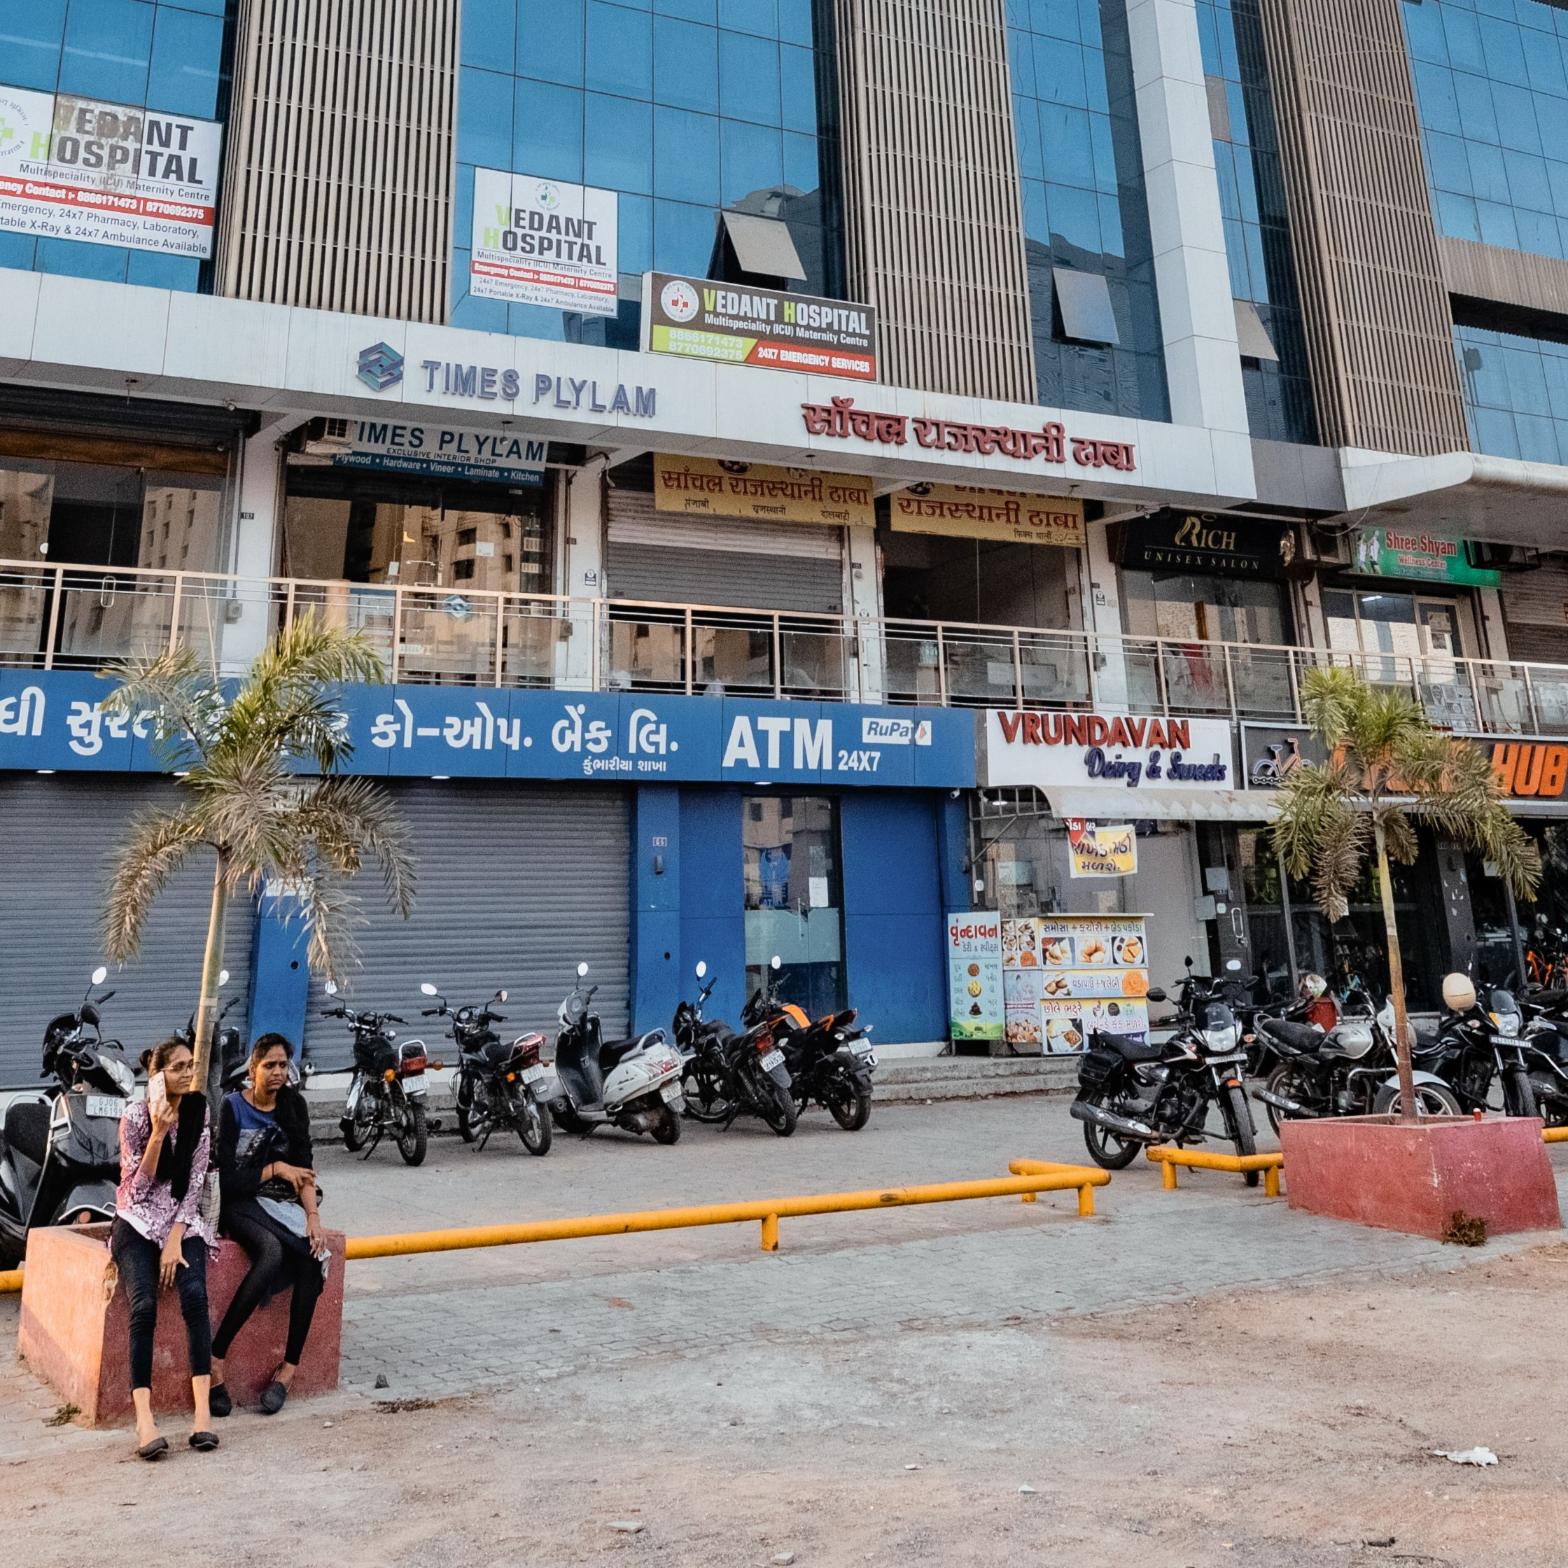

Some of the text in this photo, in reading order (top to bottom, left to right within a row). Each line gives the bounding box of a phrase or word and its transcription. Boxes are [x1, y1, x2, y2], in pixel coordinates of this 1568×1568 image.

[54, 97, 194, 152] VEDANT
[30, 131, 204, 186] HOSPITAL
[19, 163, 211, 202] Multispeciality Maternity Centre
[24, 182, 66, 200] Contact
[28, 221, 61, 236] X-Ray
[64, 224, 72, 235] &
[74, 225, 100, 238] 24x7
[101, 229, 160, 249] Ambulance
[161, 238, 208, 255] Available
[58, 207, 83, 221] 24x7
[86, 211, 141, 231] Pharmacy,
[142, 220, 200, 239] Laboratory,
[494, 202, 598, 241] VEDANT
[483, 226, 607, 267] HOSPITAL
[702, 287, 871, 336] VEDANT HOSPITAL
[704, 312, 869, 348] Multispeciality (ICU) Maternity Centre
[757, 346, 871, 374] 24X7 EMERGENCY SERVICES
[419, 359, 657, 418] TIMES PLYLAM
[354, 419, 545, 463] IMES PLYLAM
[386, 447, 498, 466] EXCLUSIVE INTERIOR SHOP
[912, 416, 1066, 464] राजस्थानी
[335, 452, 540, 484] Plywood Hardware Vineer Laminate Kitchen
[728, 476, 824, 503] राजस्थानी
[896, 497, 1022, 526] राजस्थानी
[1173, 515, 1237, 552] RICH
[1385, 530, 1458, 558] Shree Shyam
[1143, 551, 1261, 571] UNISEX SALON
[551, 703, 613, 755] બેંક
[721, 715, 834, 771] ATM
[997, 711, 1192, 750] VRUNDAVAN
[837, 749, 882, 773] 24X7
[1084, 747, 1228, 788] Dairy & Sweets
